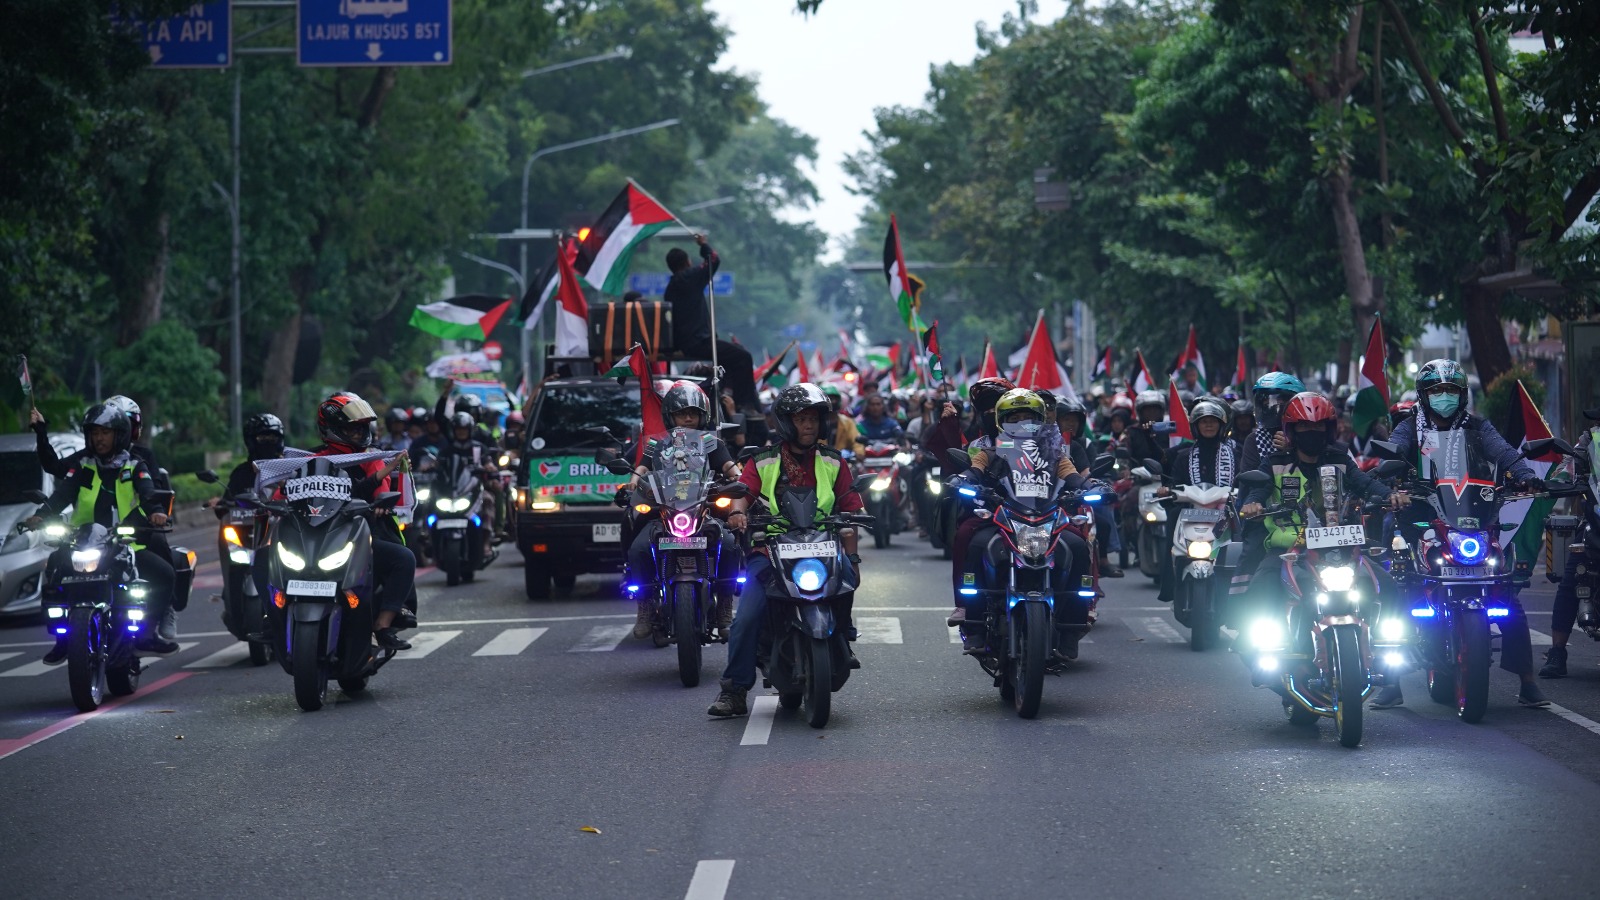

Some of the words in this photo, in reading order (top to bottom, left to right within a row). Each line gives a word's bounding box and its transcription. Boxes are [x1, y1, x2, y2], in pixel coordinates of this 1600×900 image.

[180, 20, 213, 42] API
[307, 23, 350, 40] LAJUR
[354, 23, 409, 40] KHUSUS
[414, 23, 441, 39] BST
[1012, 469, 1053, 486] DAKAR
[595, 525, 606, 536] AD
[1308, 529, 1320, 539] AD
[1323, 527, 1346, 537] 3437
[1349, 525, 1362, 535] CA
[781, 544, 792, 552] AD
[796, 543, 818, 551] 5829
[824, 541, 835, 549] YU
[1443, 567, 1453, 576] AD
[1455, 567, 1475, 576] 3201
[290, 581, 299, 589] AD
